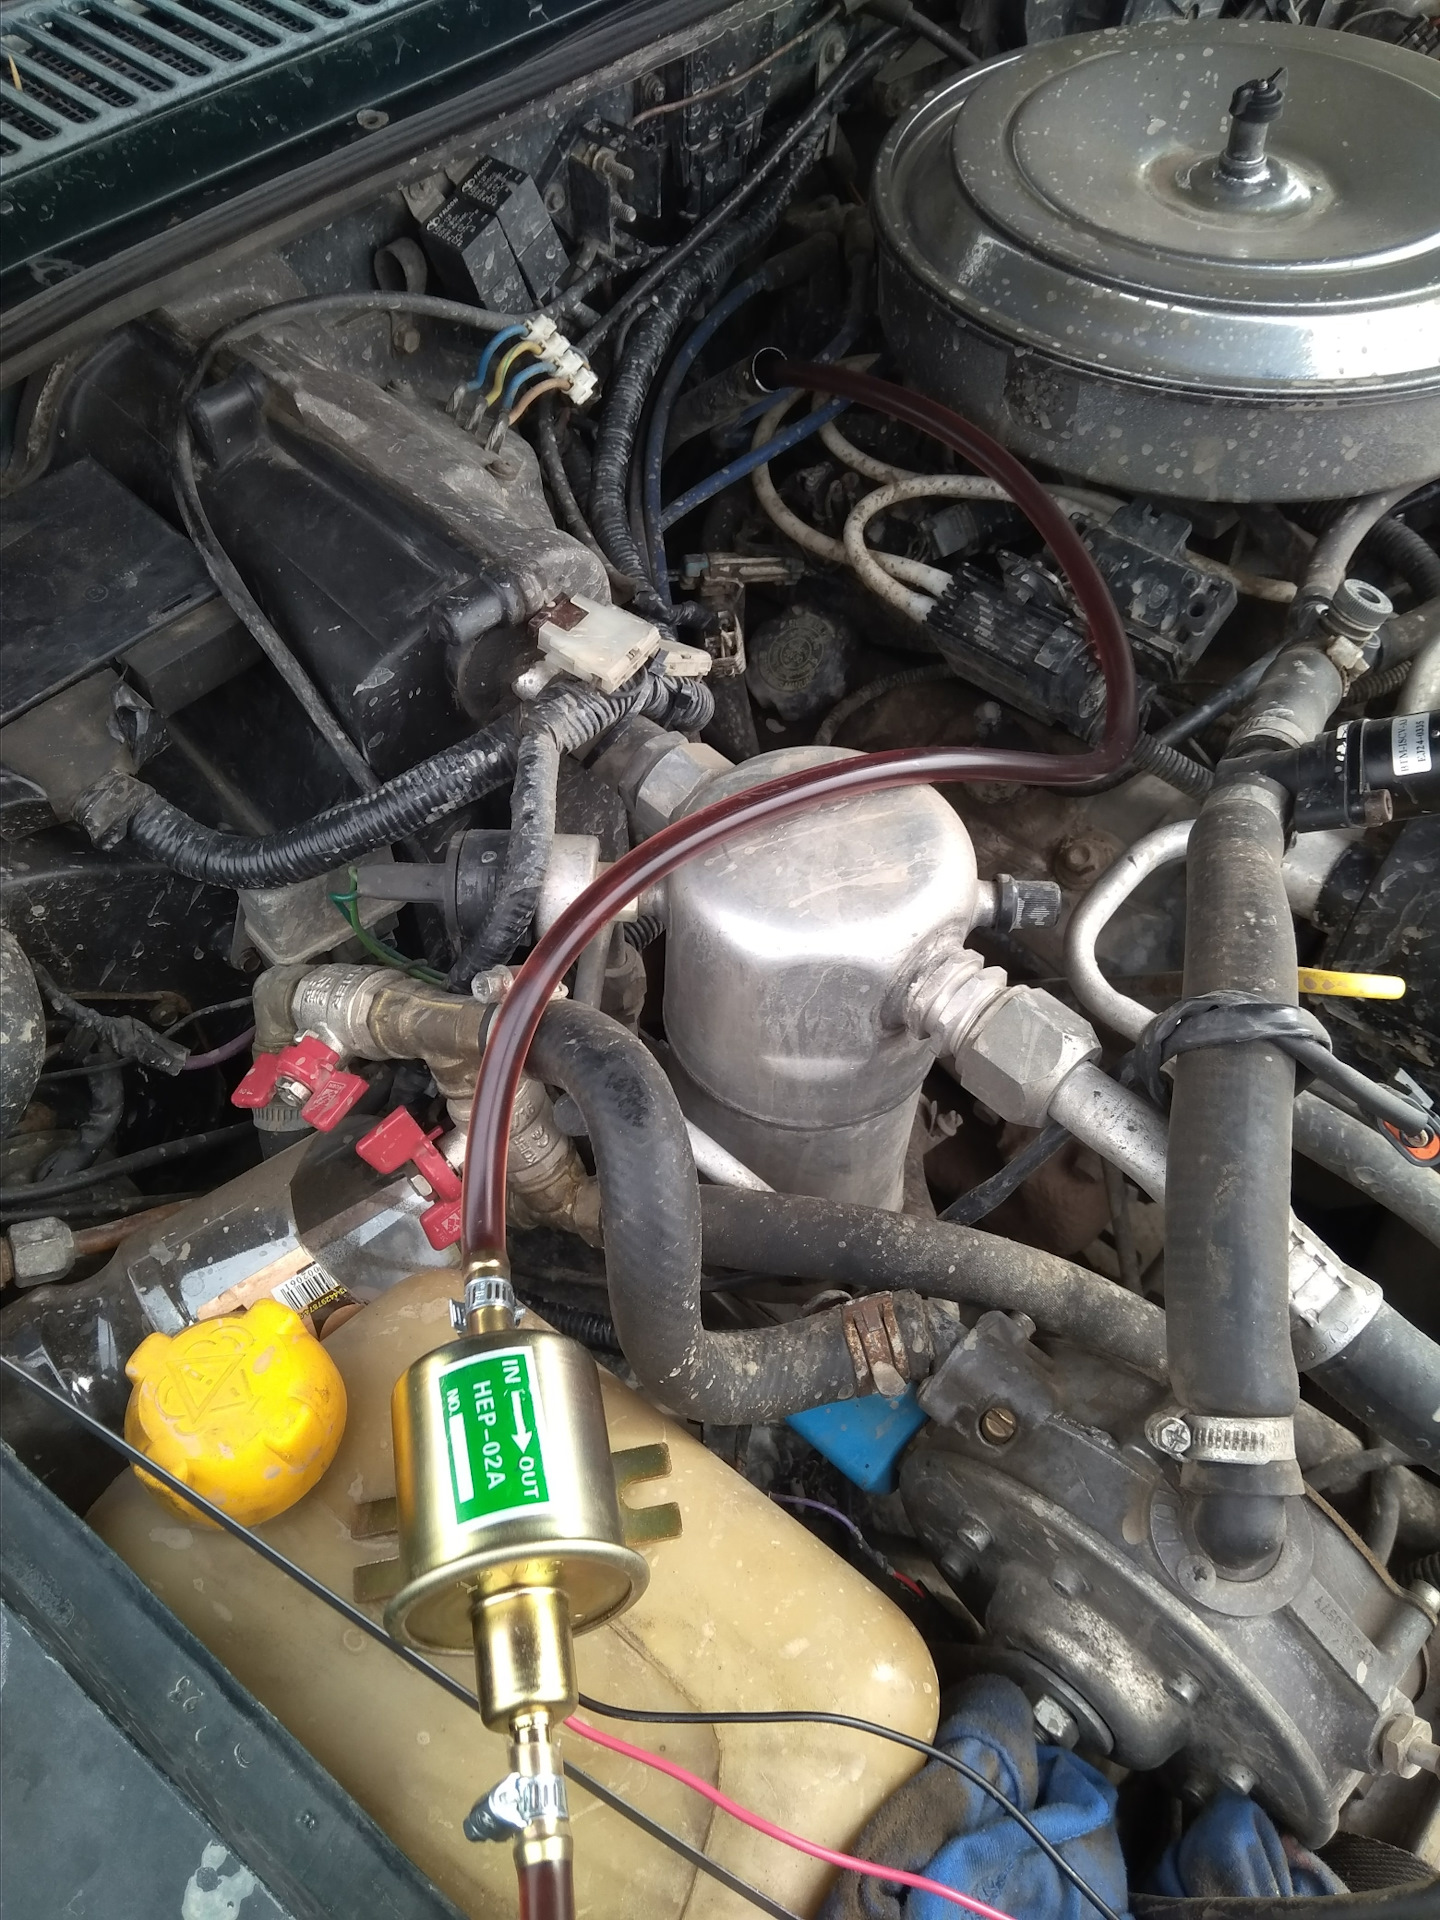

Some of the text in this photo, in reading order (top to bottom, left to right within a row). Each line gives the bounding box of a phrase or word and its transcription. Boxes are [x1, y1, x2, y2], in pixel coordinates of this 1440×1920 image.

[439, 198, 459, 218] FALCON
[284, 1265, 320, 1291] 002061
[446, 1387, 461, 1417] NO.
[472, 1379, 507, 1491] HEP-02A
[502, 1359, 540, 1499] IN OUT
